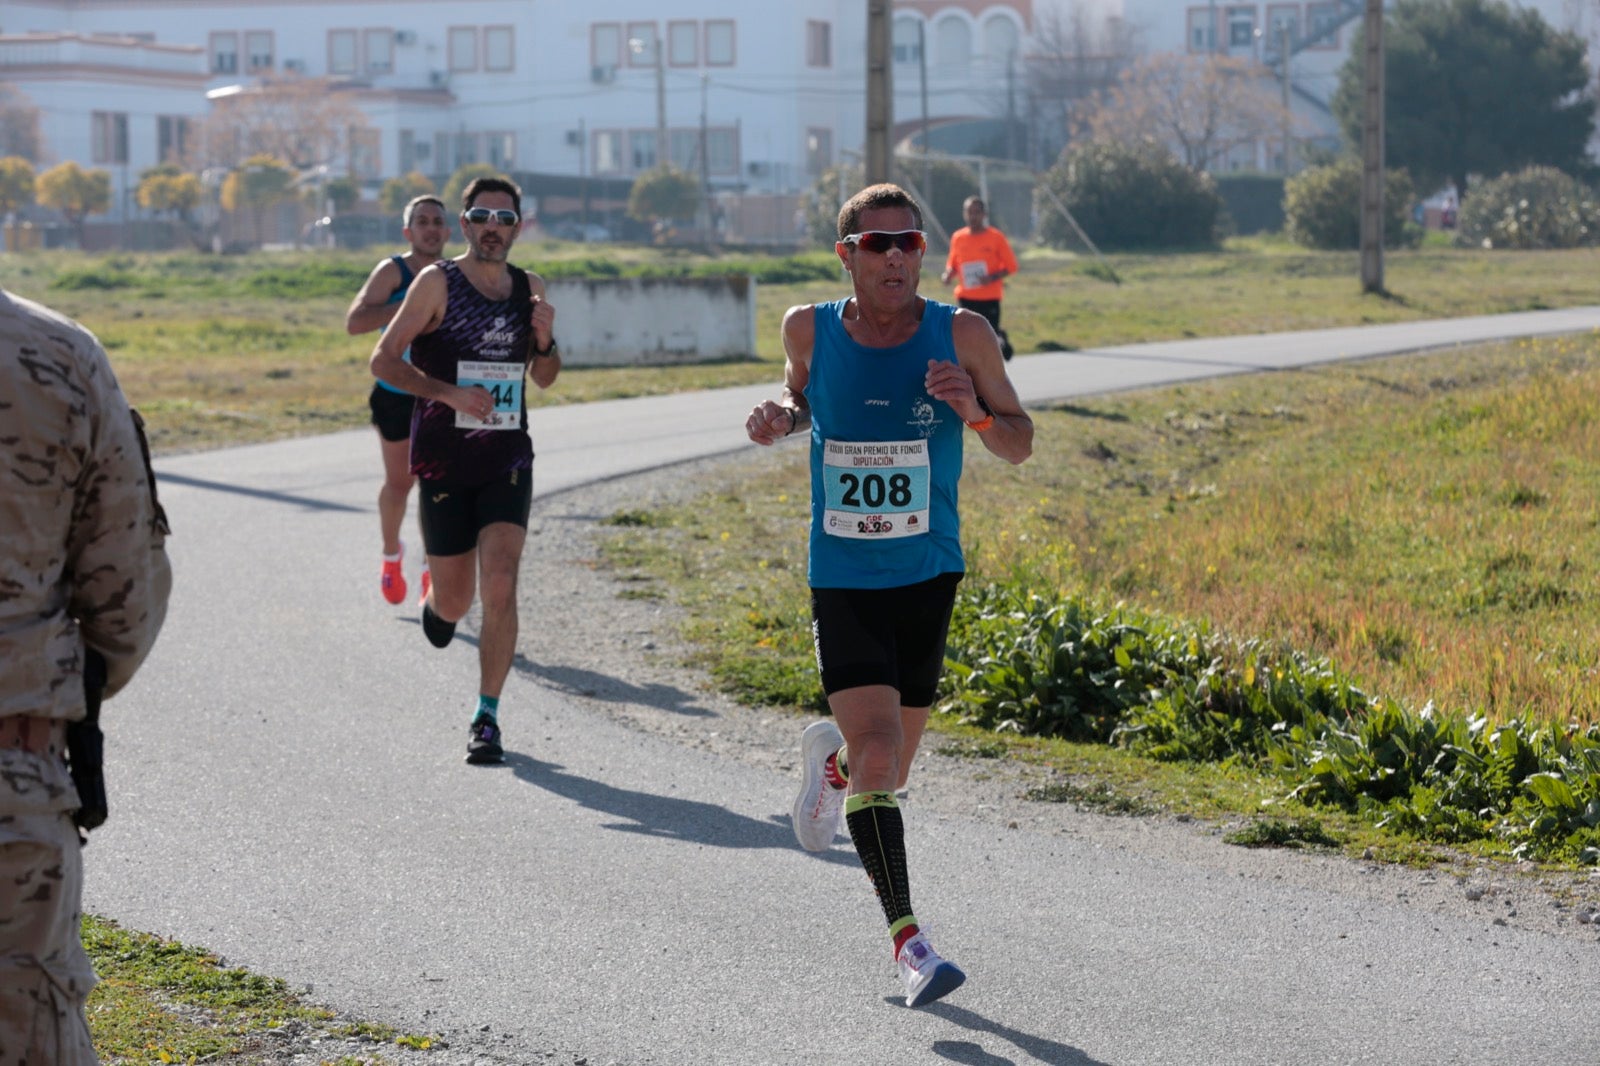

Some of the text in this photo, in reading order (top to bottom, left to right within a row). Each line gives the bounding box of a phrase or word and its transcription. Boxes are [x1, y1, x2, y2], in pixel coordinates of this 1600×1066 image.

[844, 445, 862, 455] GRAN
[863, 446, 889, 455] PREMIO
[890, 445, 899, 455] DE
[900, 444, 922, 455] FONDO
[853, 456, 894, 466] DIPUTACIÓN
[839, 473, 912, 508] 208
